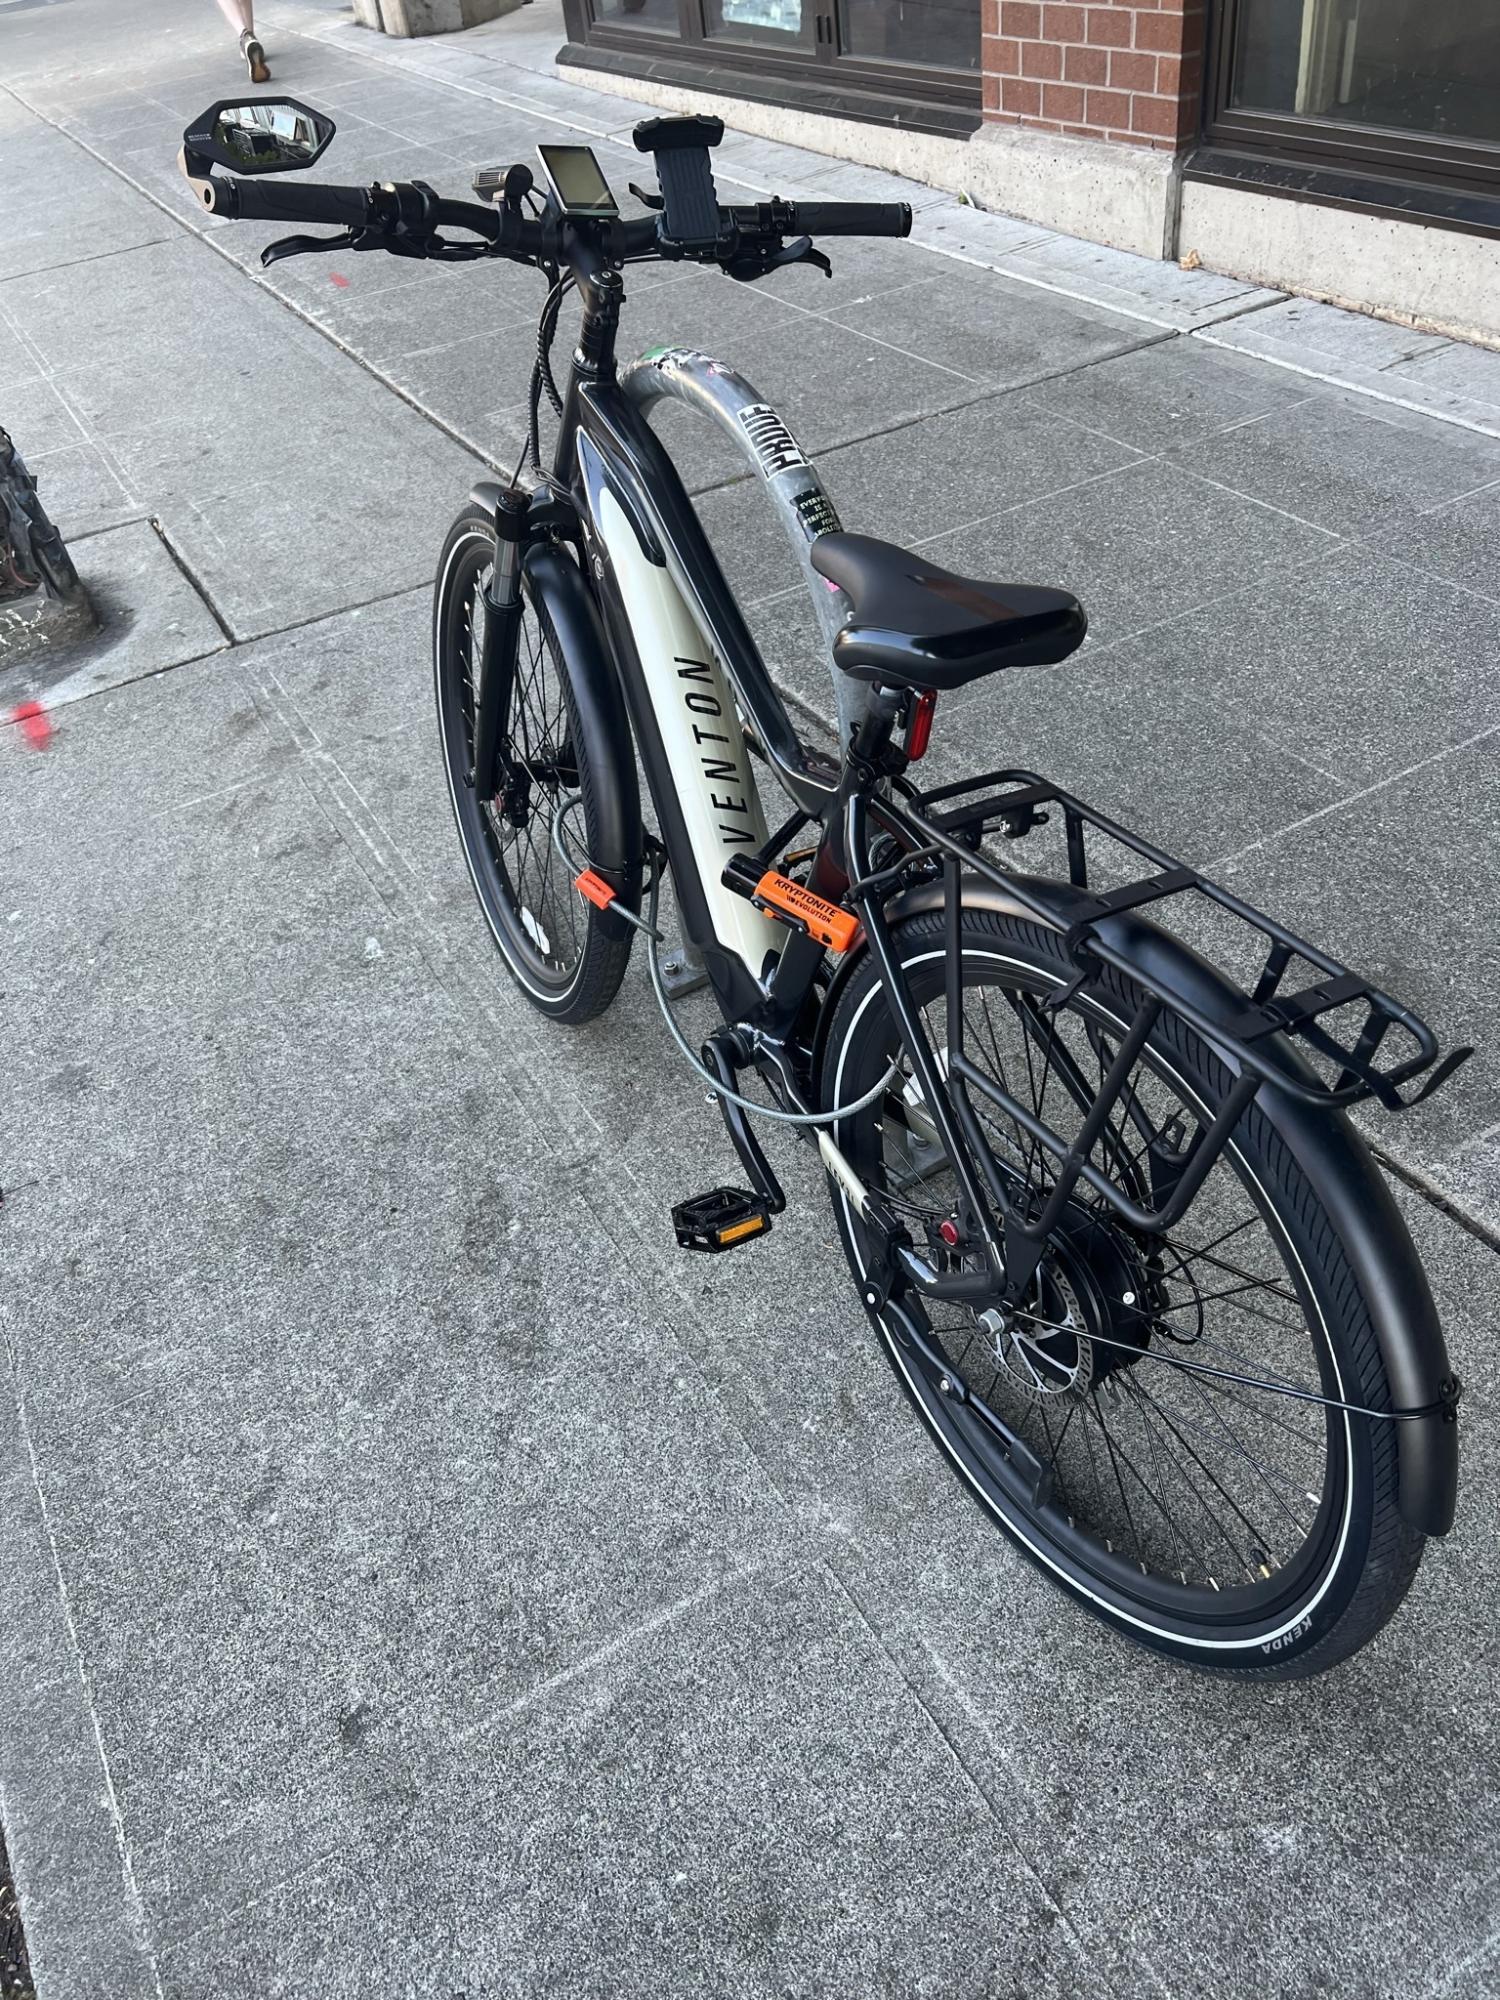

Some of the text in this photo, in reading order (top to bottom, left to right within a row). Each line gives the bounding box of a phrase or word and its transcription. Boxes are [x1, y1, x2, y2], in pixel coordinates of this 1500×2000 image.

[674, 657, 755, 843] VENTON
[774, 879, 837, 917] KRYPTONITE
[794, 901, 832, 923] EVOLUTION
[1261, 1615, 1312, 1654] KENDA
